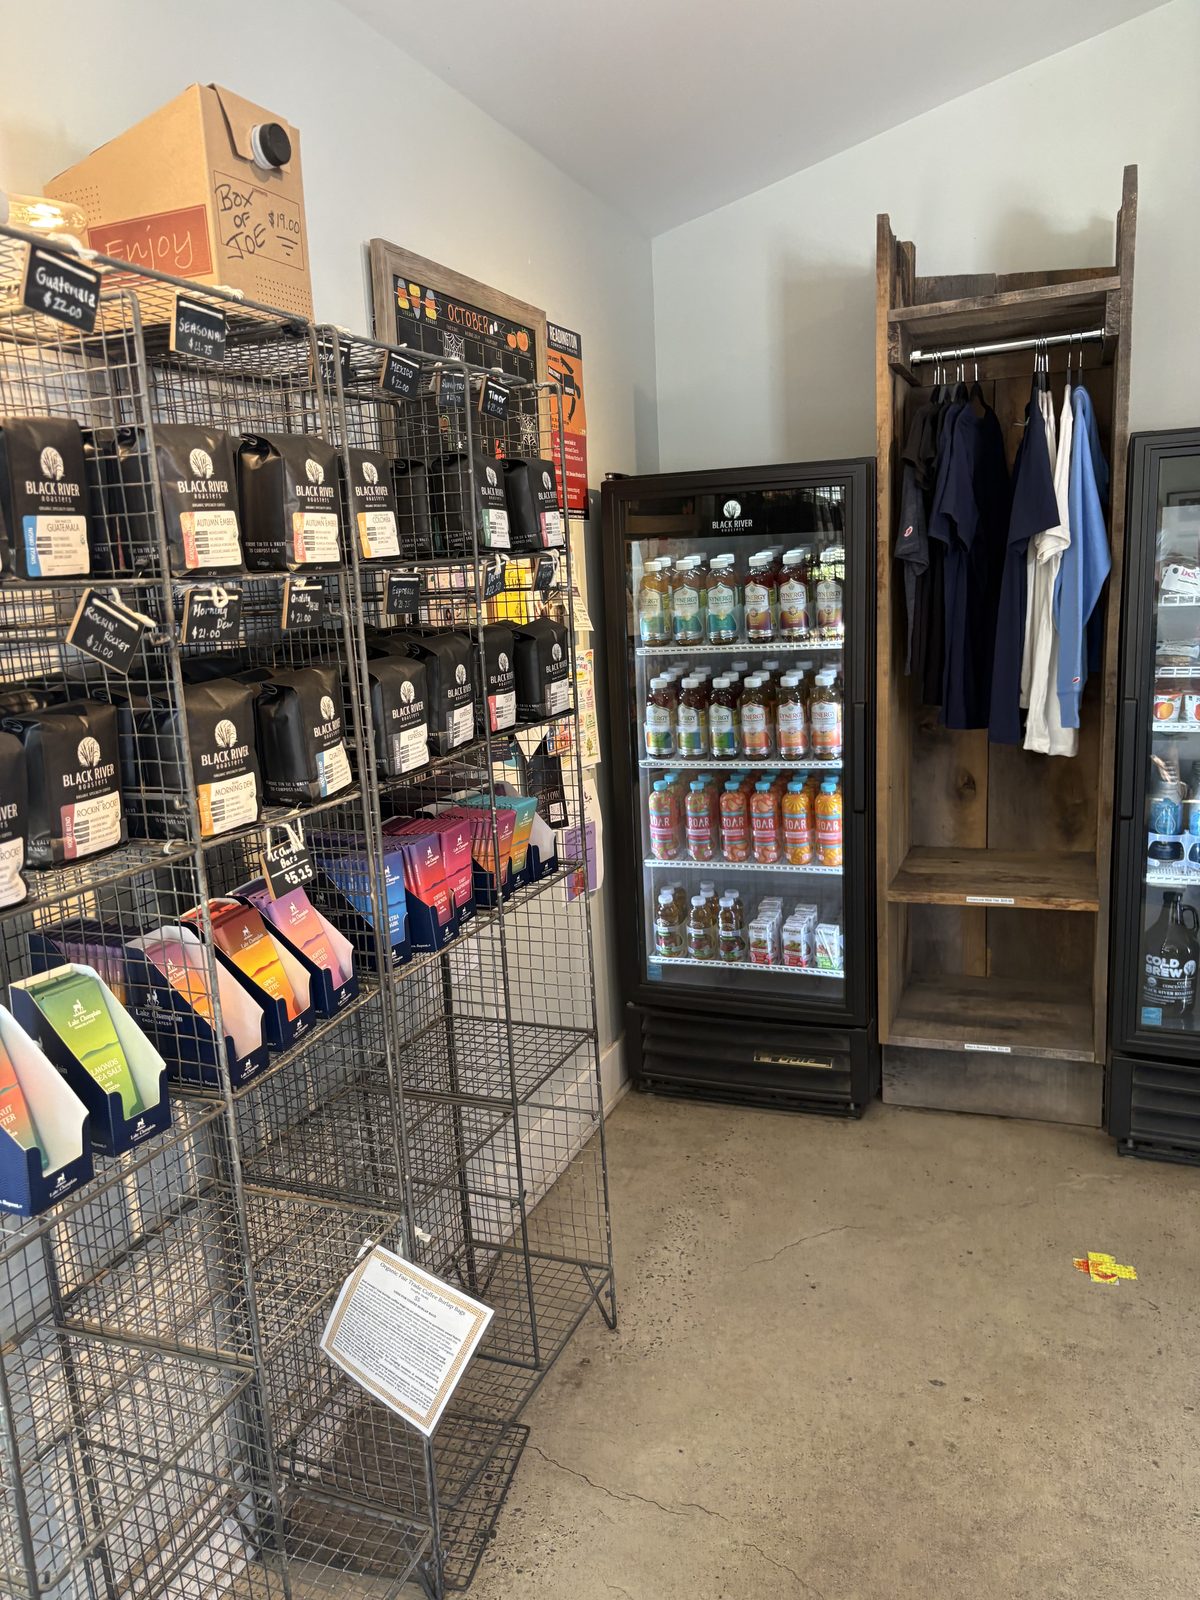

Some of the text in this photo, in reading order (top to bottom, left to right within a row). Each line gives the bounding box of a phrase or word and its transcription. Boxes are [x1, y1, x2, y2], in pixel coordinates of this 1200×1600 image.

[215, 184, 254, 211] Box
[234, 212, 250, 228] OF
[105, 226, 193, 270] Enjoy
[226, 223, 266, 260] JOE
[36, 266, 96, 308] Guatemala
[447, 304, 490, 335] OCTOBER
[178, 317, 226, 342] SEASONAL
[26, 481, 80, 496] BLACK RIVER
[177, 481, 229, 493] BLACK RIVER
[296, 485, 334, 497] BLACK RIVER
[355, 486, 388, 497] BLACK RIVER
[481, 486, 495, 496] BLACK
[538, 491, 550, 500] BLACK
[47, 523, 80, 532] GUATEMALA
[712, 519, 753, 529] BLACK RIVER
[193, 603, 228, 620] Morning
[191, 626, 220, 640] $21.00
[545, 663, 560, 673] BLACK
[490, 674, 506, 684] BLACK
[447, 686, 463, 698] BLACK
[391, 701, 424, 719] BLACK RIVER
[314, 723, 333, 738] BLACK
[201, 745, 249, 766] BLACK RIVER
[63, 764, 115, 787] BLACK RIVER
[214, 783, 243, 797] MORNING
[688, 816, 710, 828] ROAR
[752, 817, 775, 829] ROAR
[785, 818, 808, 830] ROAR
[280, 855, 298, 869] Bars
[1146, 954, 1180, 969] COLD
[1145, 963, 1183, 978] BREW
[107, 1065, 123, 1077] SALT
[380, 1262, 399, 1277] Organic
